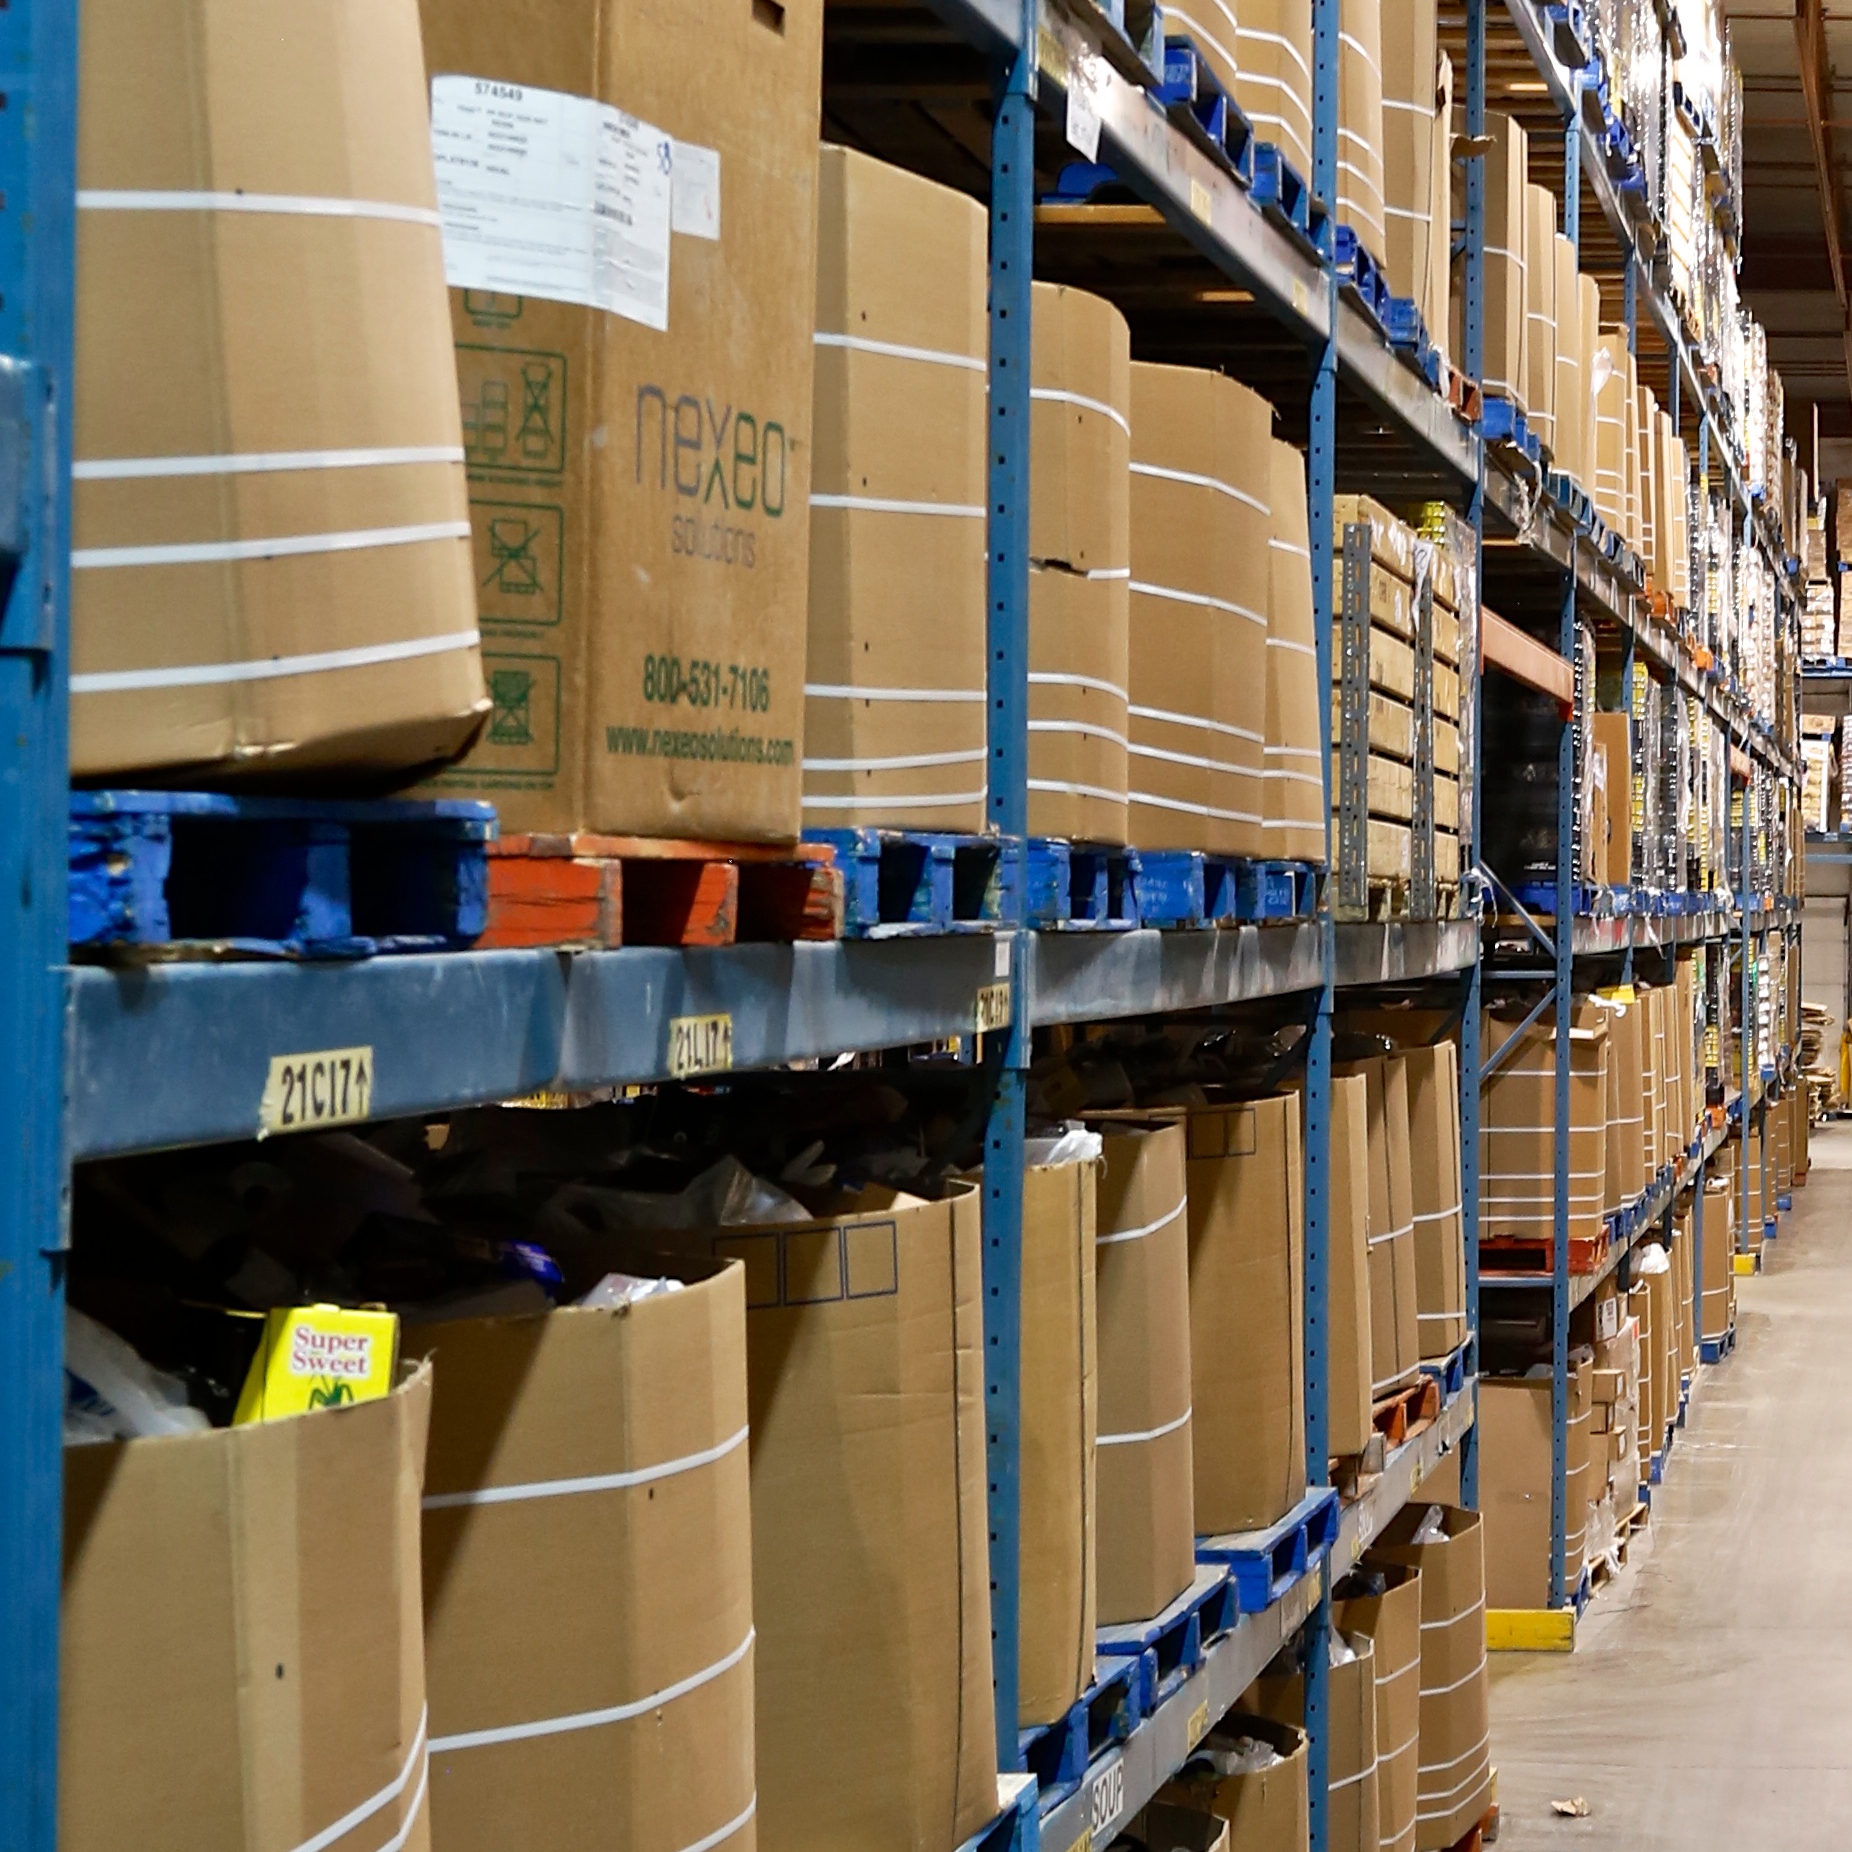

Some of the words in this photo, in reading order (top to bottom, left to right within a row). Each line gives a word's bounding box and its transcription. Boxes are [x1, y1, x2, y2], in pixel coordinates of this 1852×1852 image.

[636, 384, 786, 519] nexeo
[671, 513, 757, 571] solutions
[642, 652, 771, 713] 800-531-7106
[605, 724, 795, 768] www.nexeosolutions.com
[292, 1348, 366, 1375] Sweet
[295, 1326, 368, 1355] Super
[1092, 1762, 1124, 1831] SOUP
